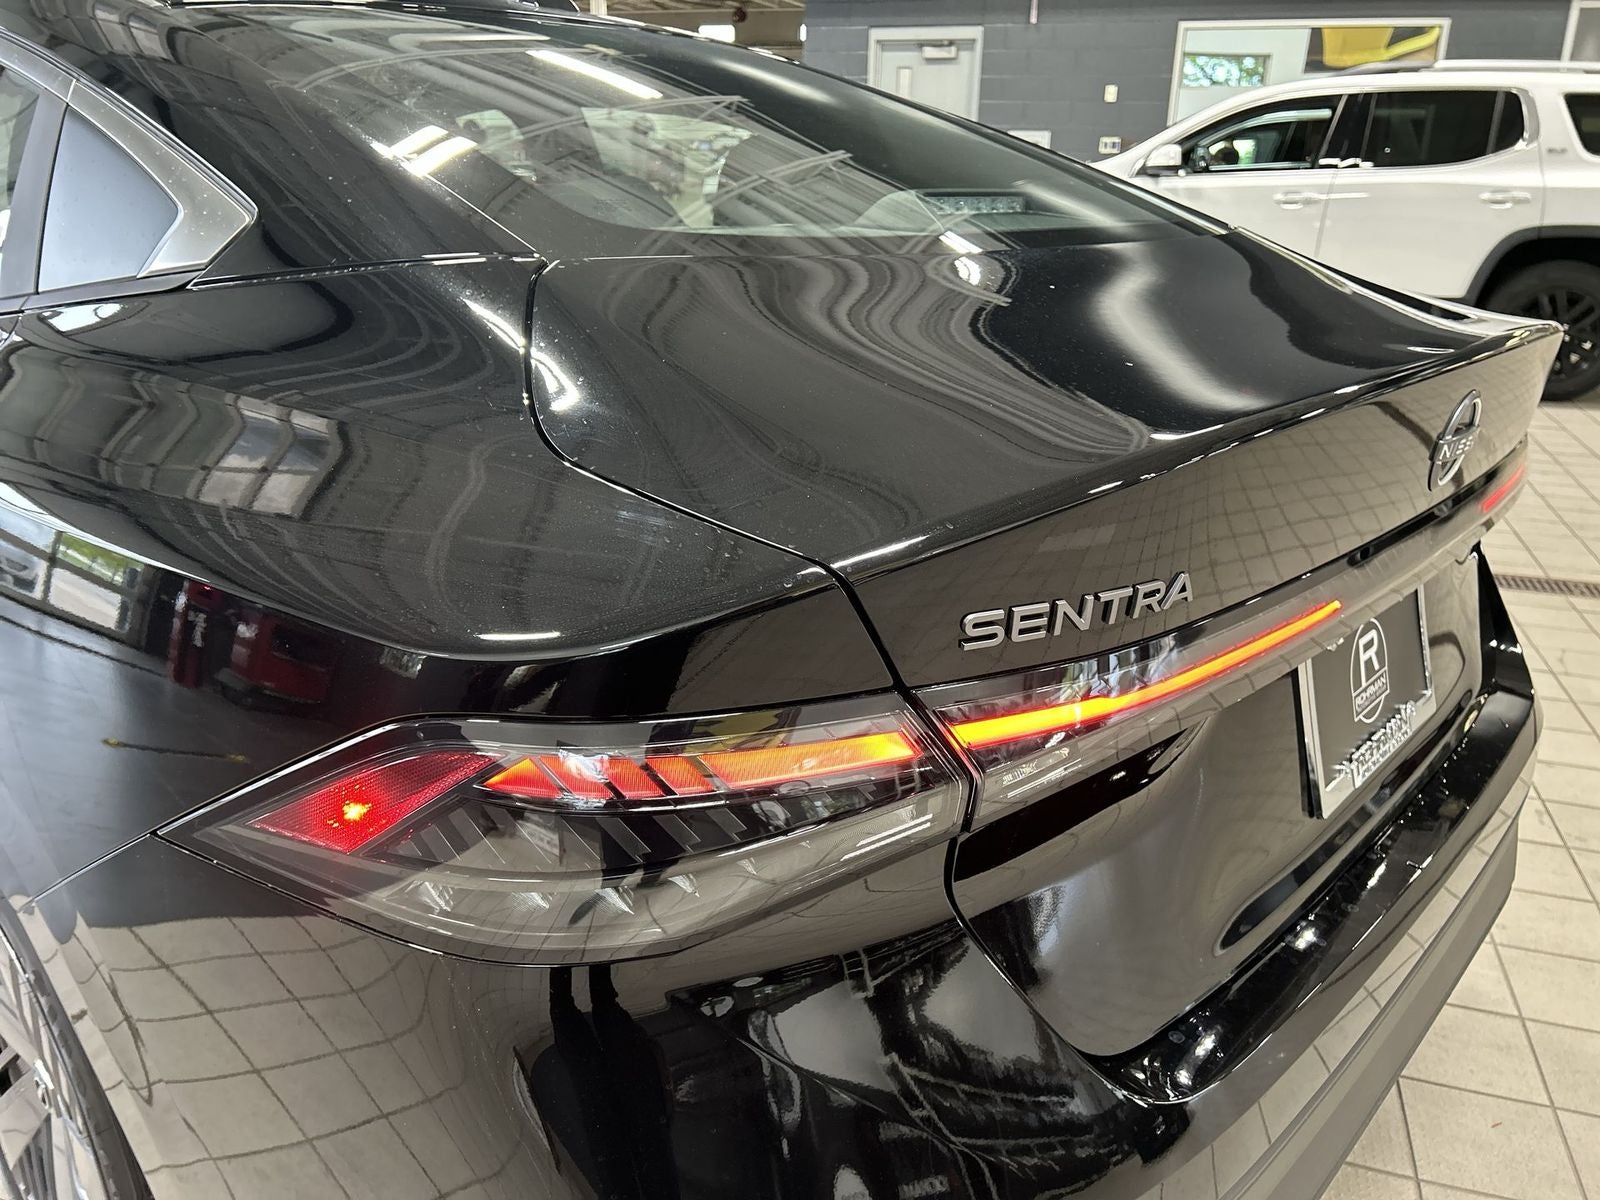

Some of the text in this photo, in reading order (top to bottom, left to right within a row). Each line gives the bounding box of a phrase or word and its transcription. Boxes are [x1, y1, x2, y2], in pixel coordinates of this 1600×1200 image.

[1438, 435, 1474, 460] NISS
[959, 569, 1194, 651] SENTRA
[1358, 628, 1381, 687] R
